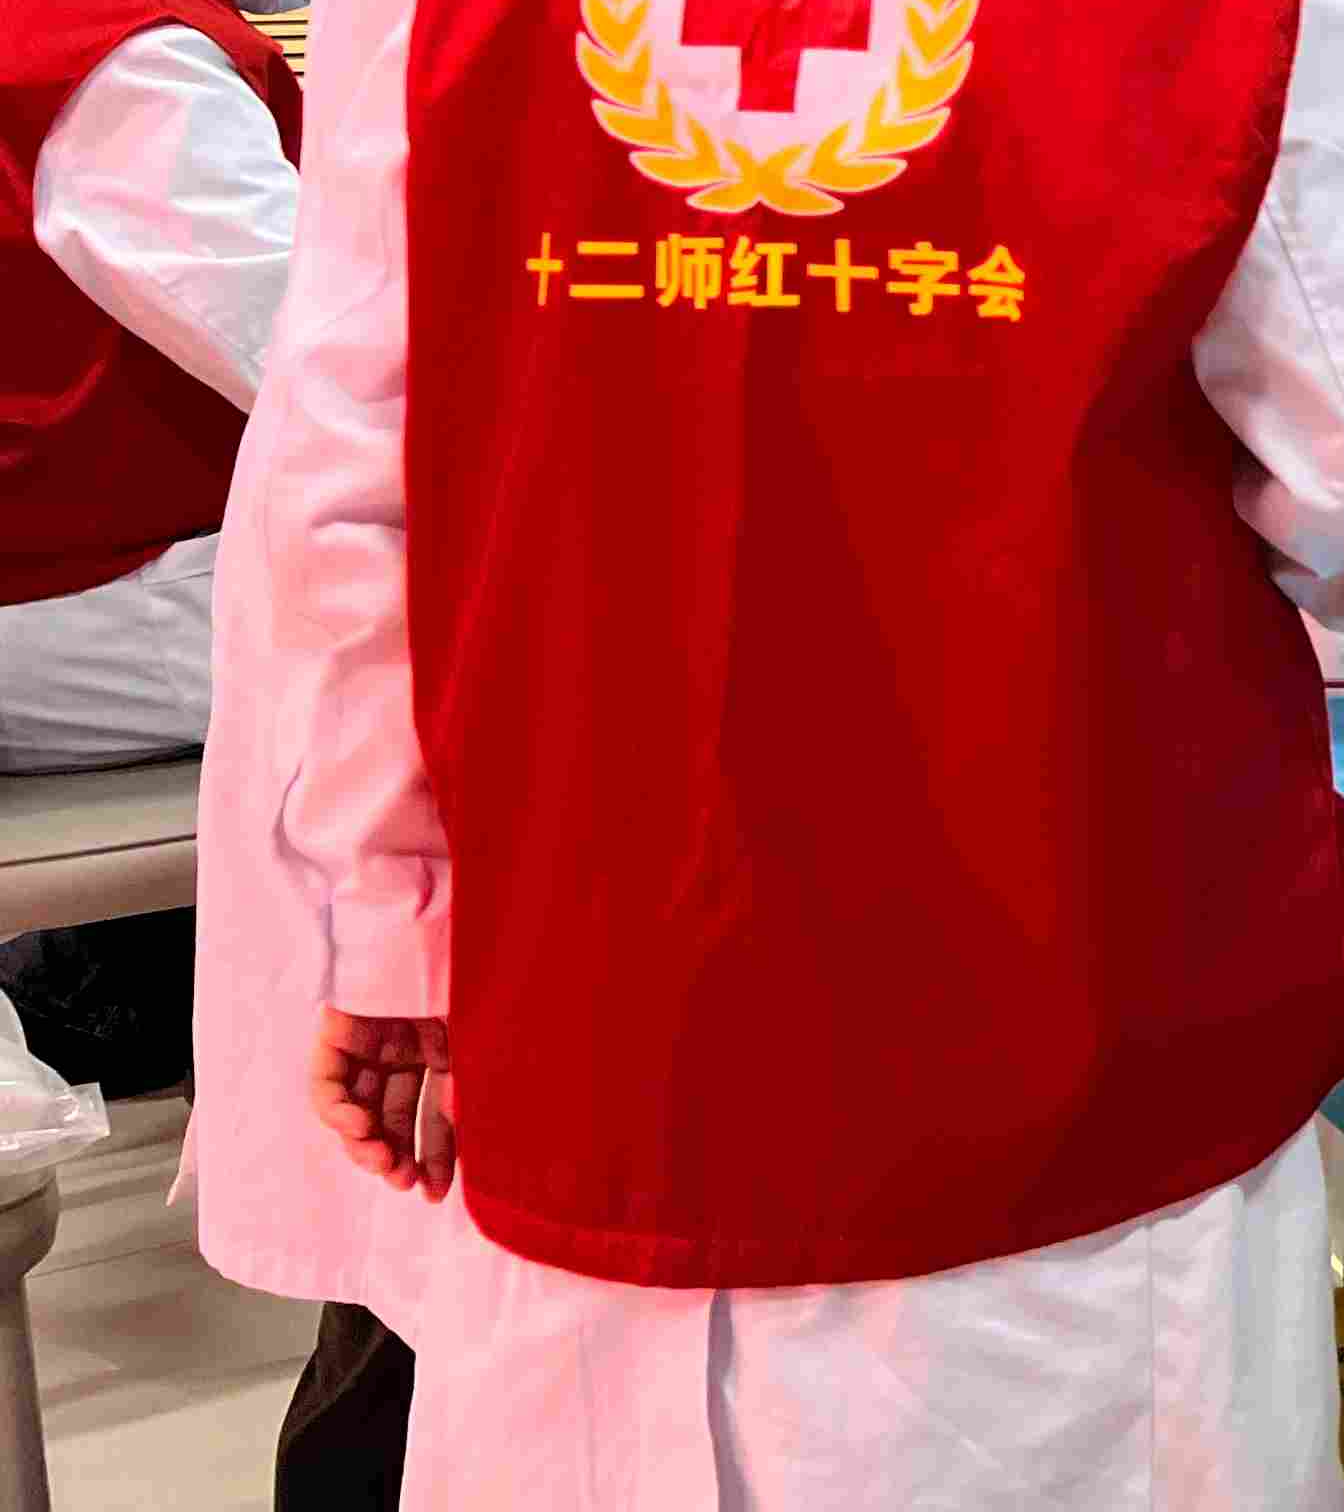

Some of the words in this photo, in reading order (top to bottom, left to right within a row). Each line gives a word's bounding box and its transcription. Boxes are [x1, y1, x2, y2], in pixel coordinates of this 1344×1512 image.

[525, 231, 1026, 323] 十二师红十字会
